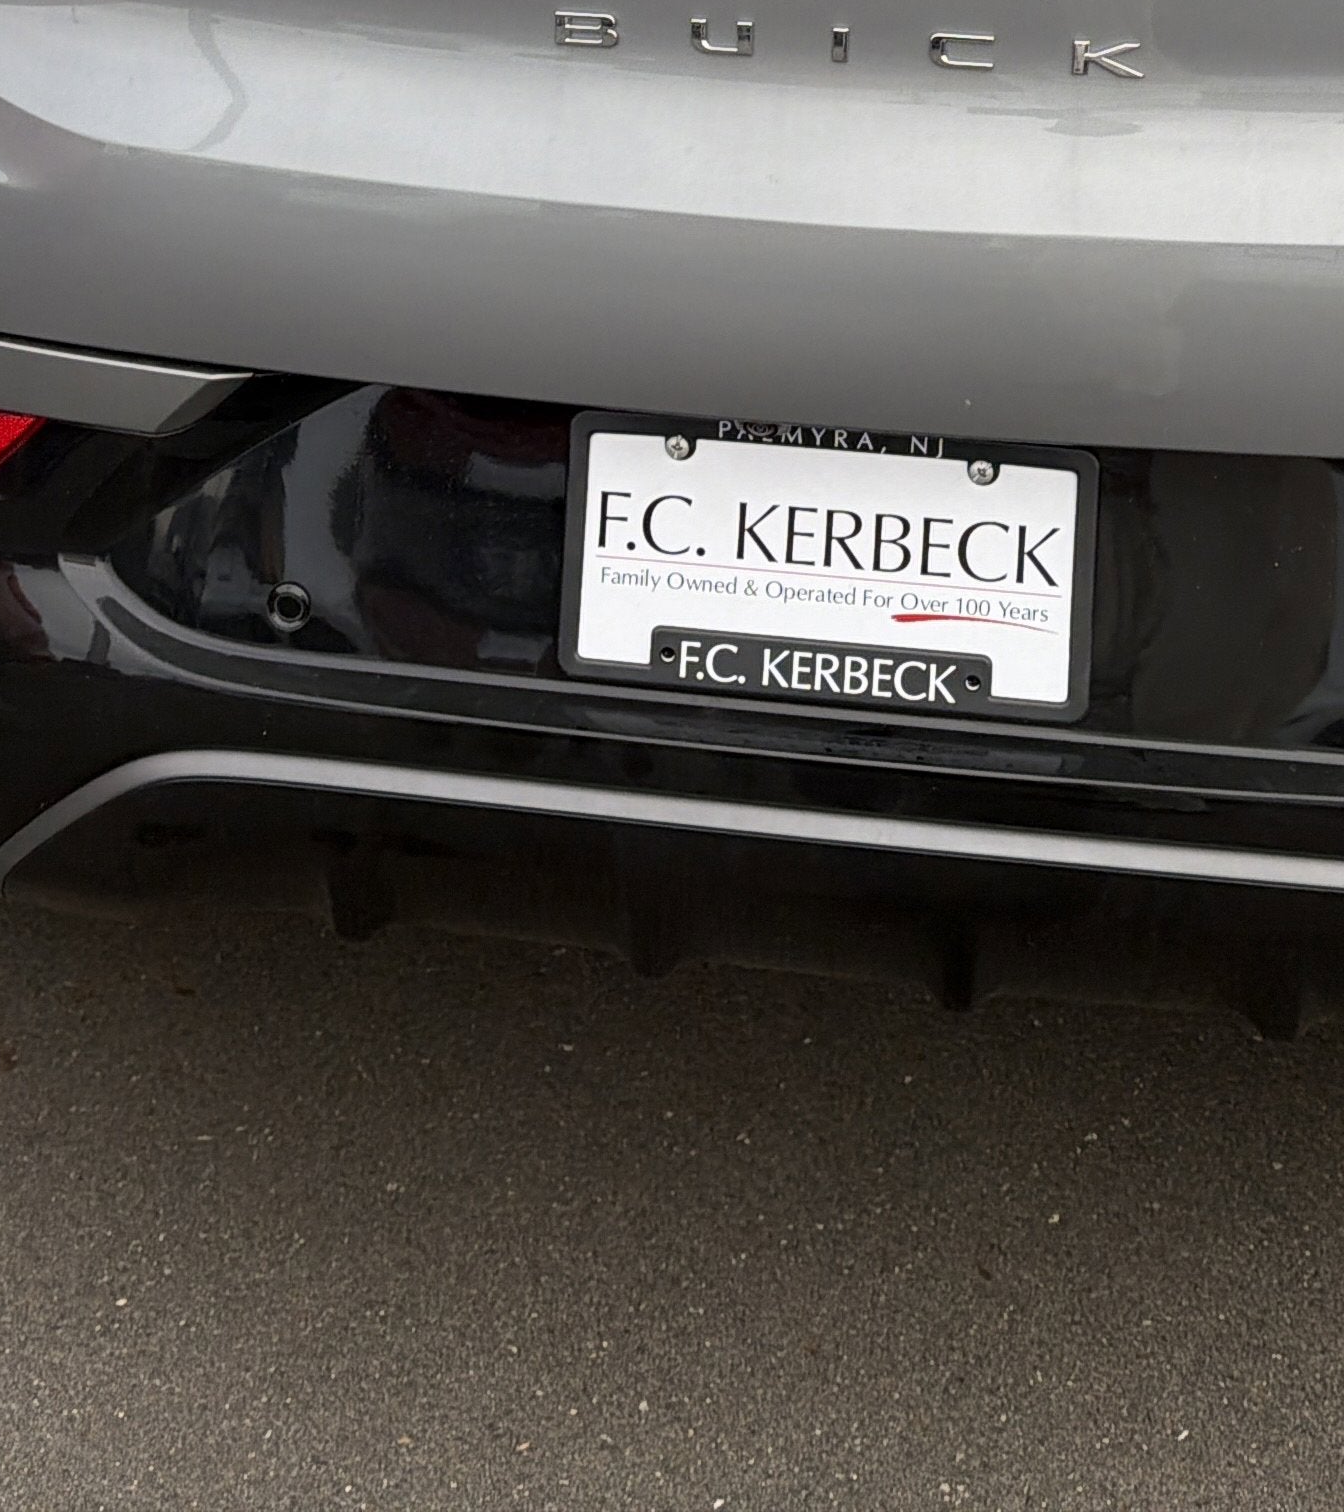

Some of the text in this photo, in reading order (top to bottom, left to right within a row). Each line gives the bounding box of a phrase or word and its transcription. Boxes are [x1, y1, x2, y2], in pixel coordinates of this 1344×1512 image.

[554, 9, 1145, 79] BUICK
[910, 434, 944, 459] NJ
[597, 489, 1060, 588] F.C. KERBECK
[600, 566, 1049, 623] Family Owned & Operated For Over 100 Years
[677, 640, 958, 704] F.C. KERBECK
